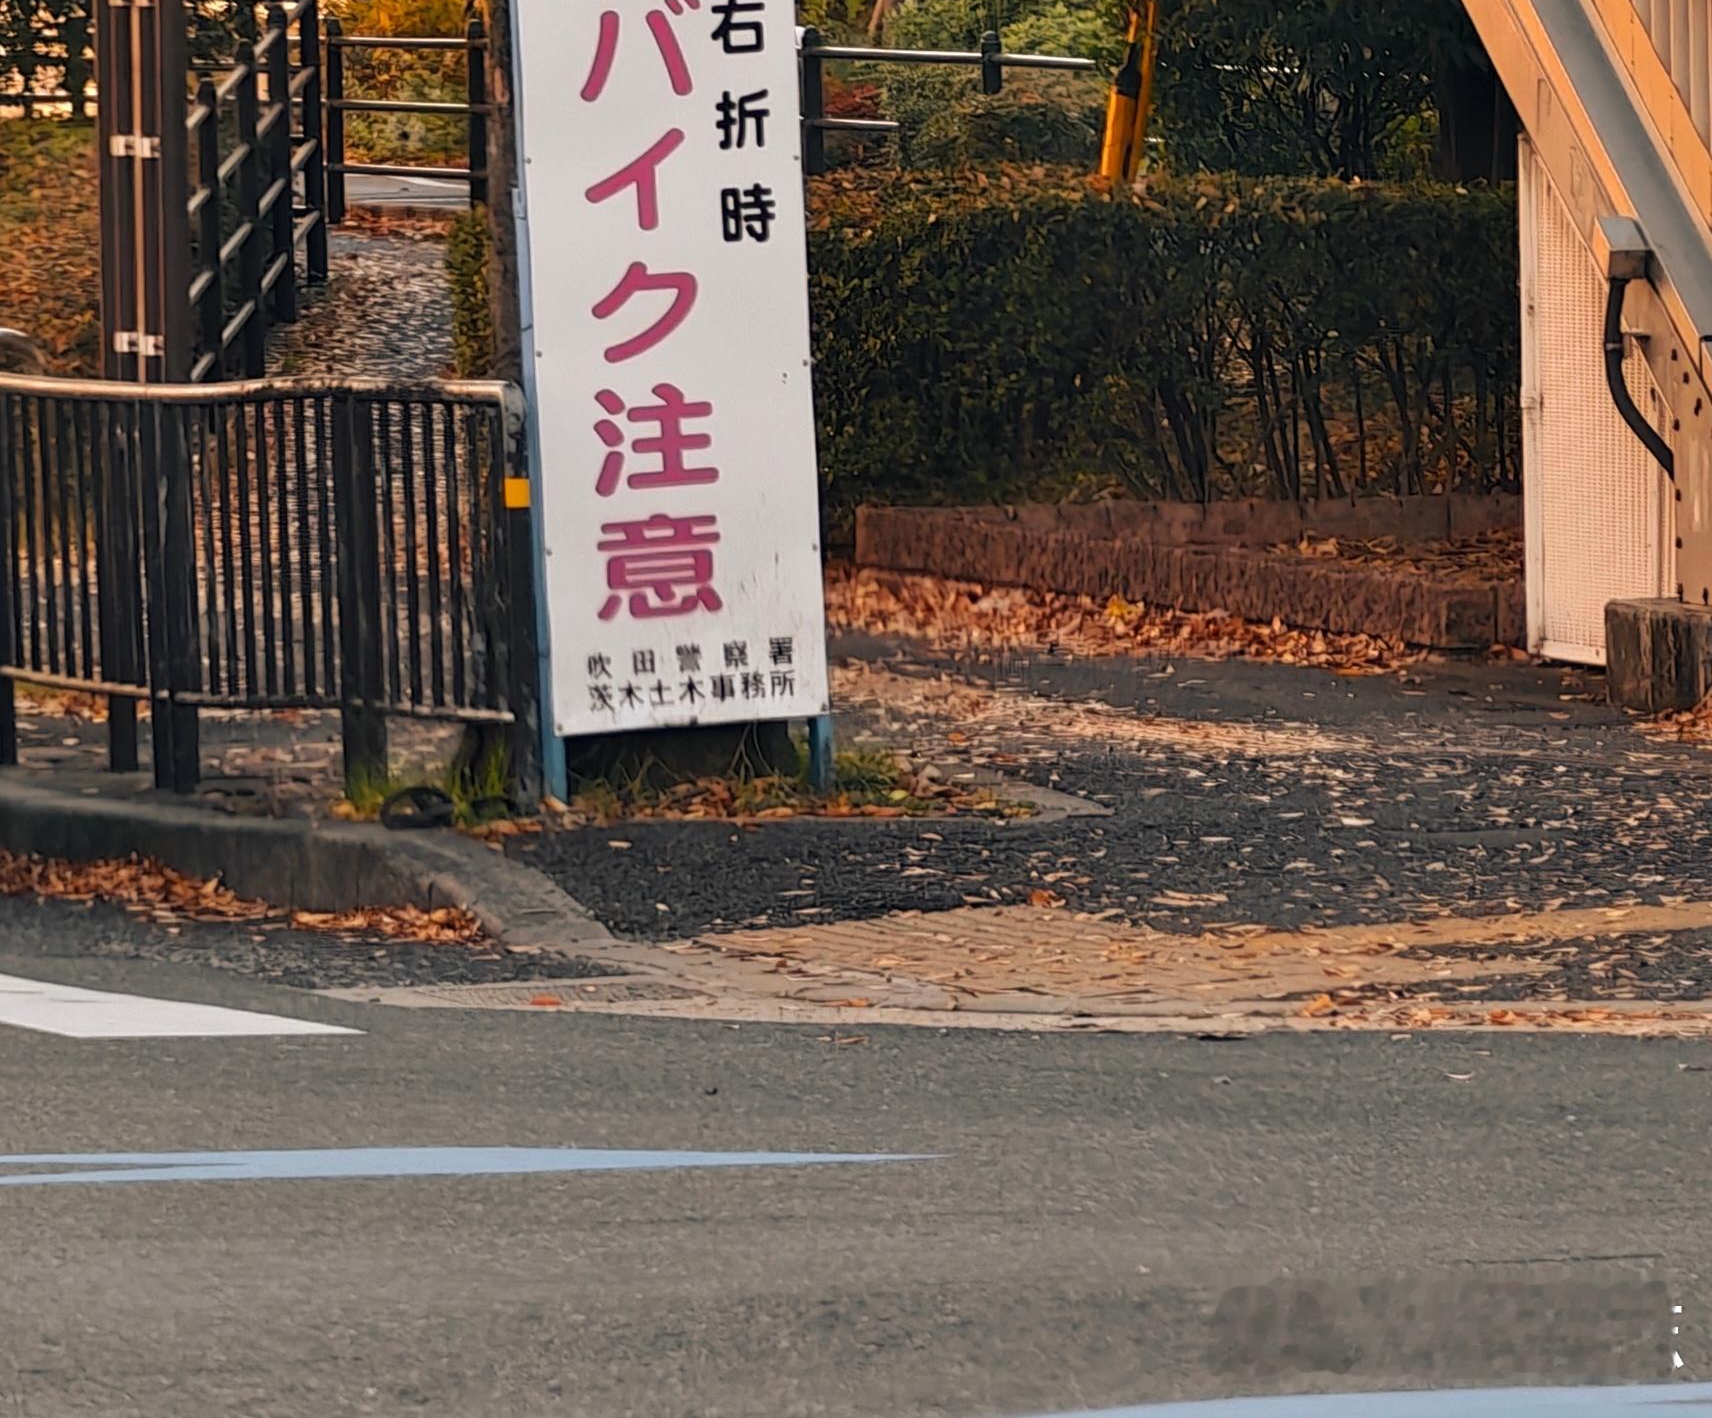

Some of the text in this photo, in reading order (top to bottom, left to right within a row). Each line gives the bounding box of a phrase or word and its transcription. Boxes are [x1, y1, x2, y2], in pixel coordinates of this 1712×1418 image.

[587, 636, 794, 680] 吹田警察署
[587, 670, 796, 713] 茨木土木事務所
